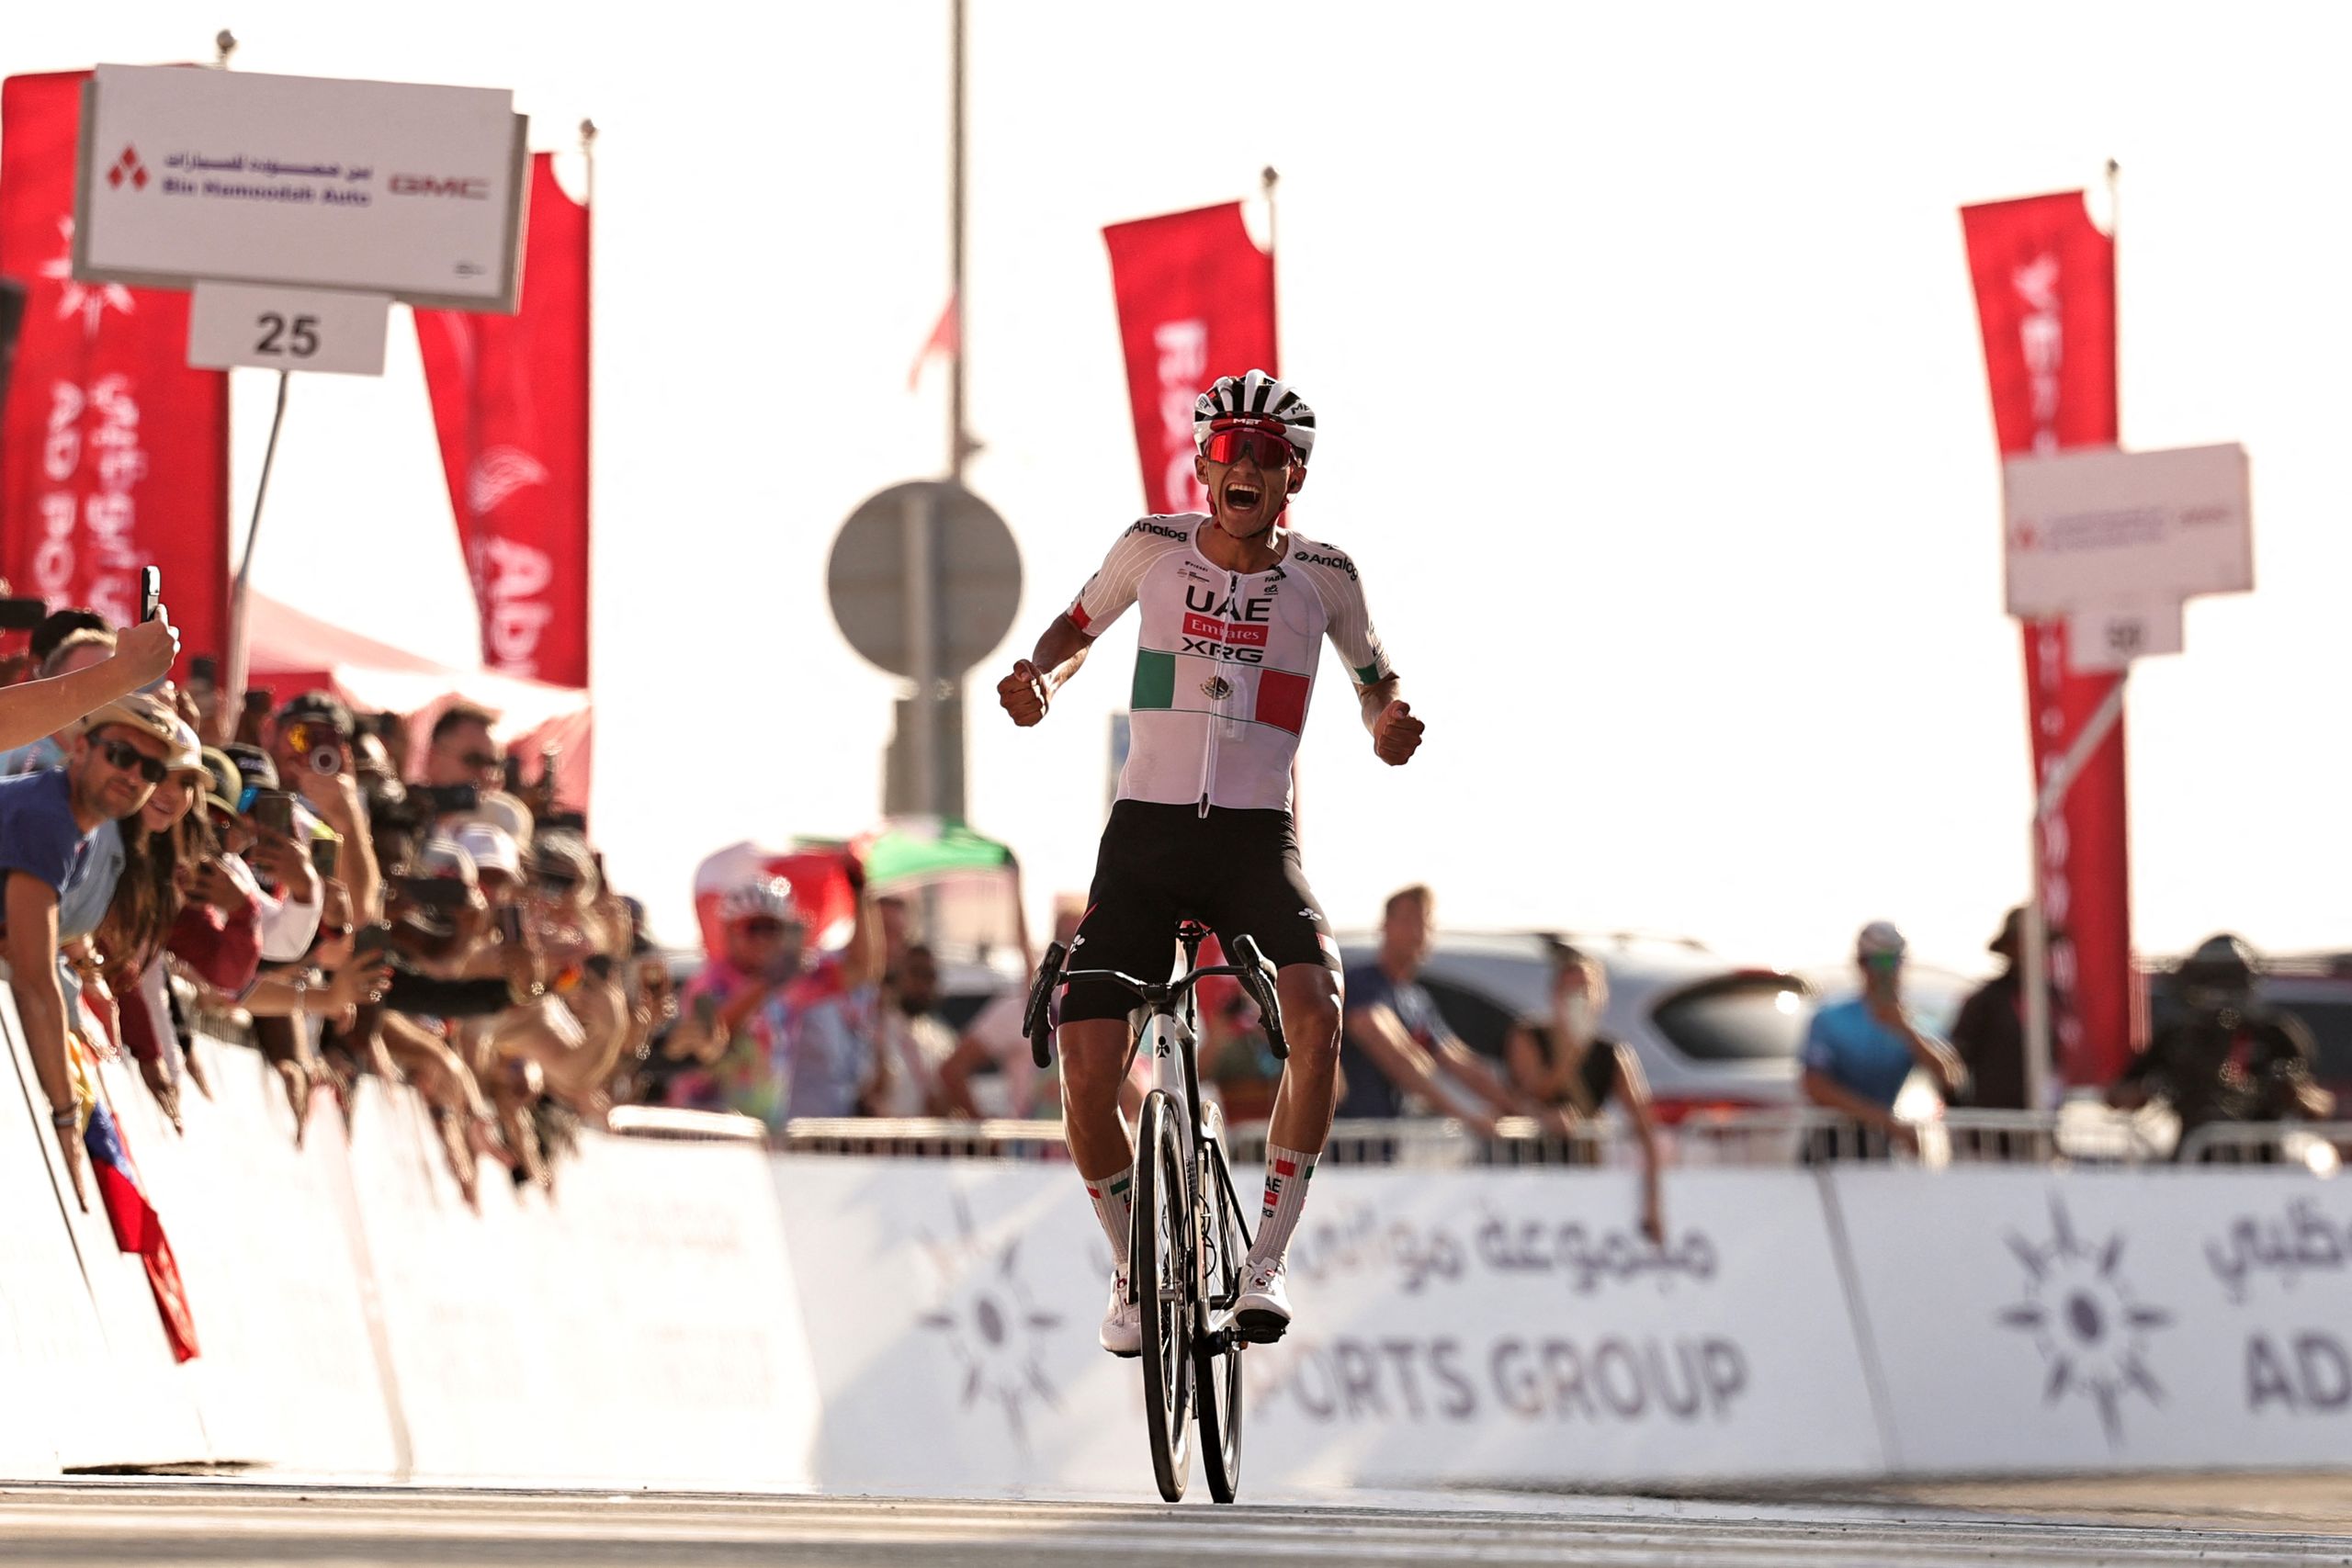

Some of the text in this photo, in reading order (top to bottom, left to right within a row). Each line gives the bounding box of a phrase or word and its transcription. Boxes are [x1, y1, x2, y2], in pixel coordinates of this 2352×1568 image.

[388, 175, 489, 199] GMC
[255, 312, 321, 358] 25
[1131, 520, 1187, 542] Analog
[1308, 554, 1359, 581] Analog
[1185, 585, 1273, 622] UAE
[1192, 619, 1260, 640] Emiates
[1182, 637, 1264, 663] XRG
[1265, 1176, 1282, 1192] AE
[1487, 1337, 1747, 1423] GROUP
[2245, 1331, 2352, 1413] AD
